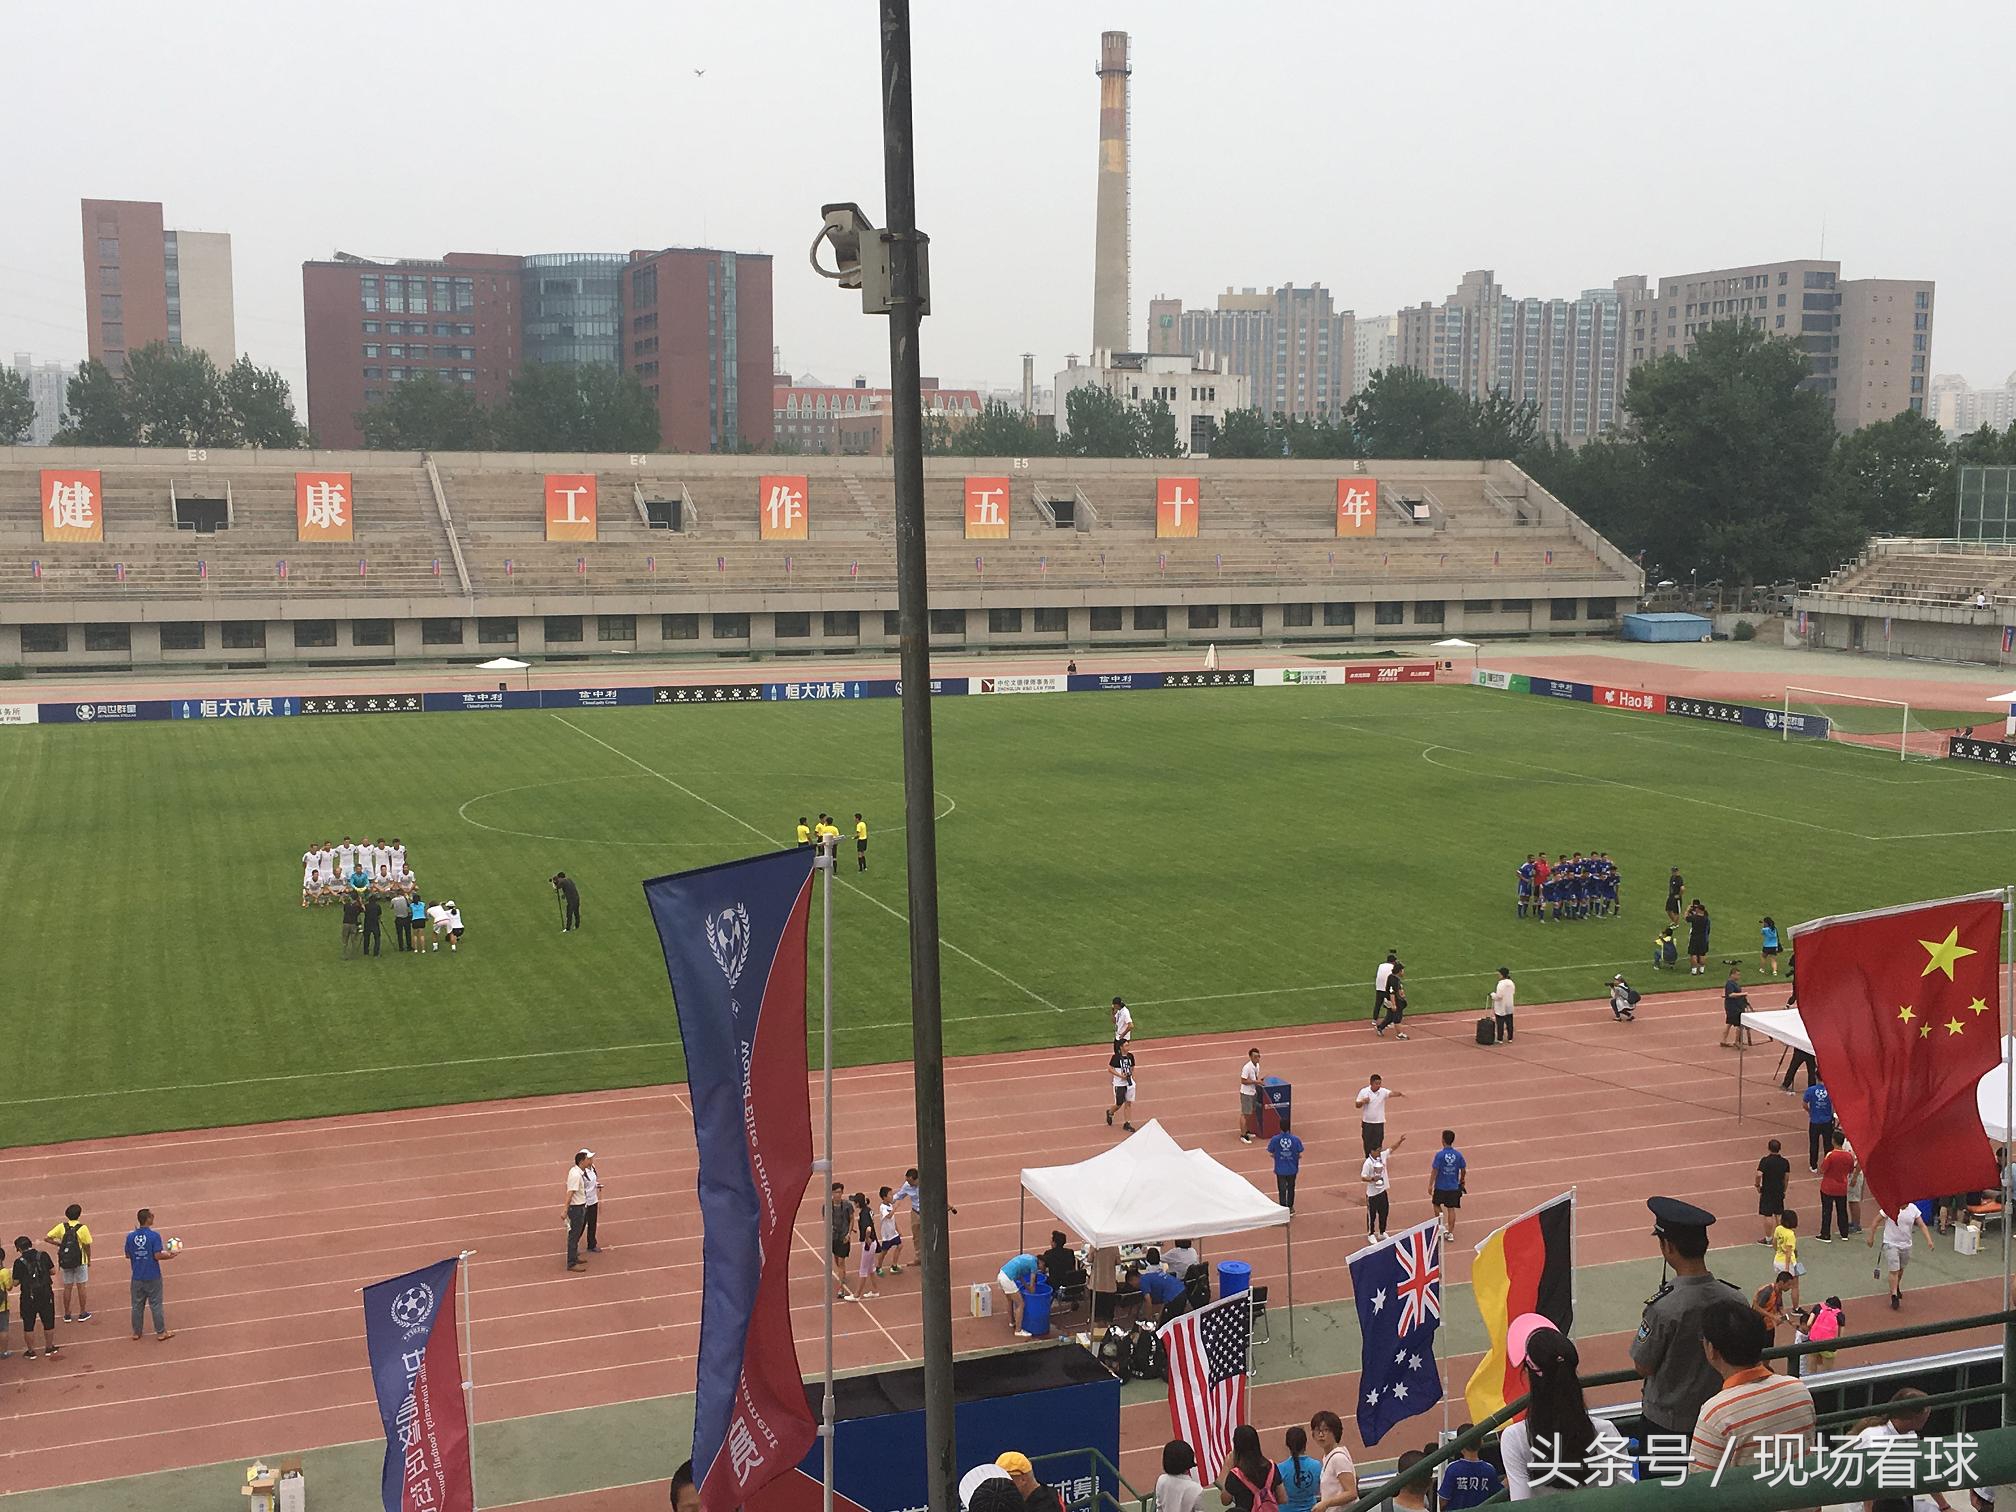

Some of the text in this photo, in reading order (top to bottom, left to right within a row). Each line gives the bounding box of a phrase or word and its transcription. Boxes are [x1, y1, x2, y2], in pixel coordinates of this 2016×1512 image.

[188, 449, 207, 461] E3
[630, 455, 647, 466] E4
[1013, 458, 1029, 469] E5
[48, 480, 1371, 529] 健 康 工 作 五 十 年
[785, 682, 846, 700] 恒大冰泉
[200, 699, 273, 718] 恒大冰泉
